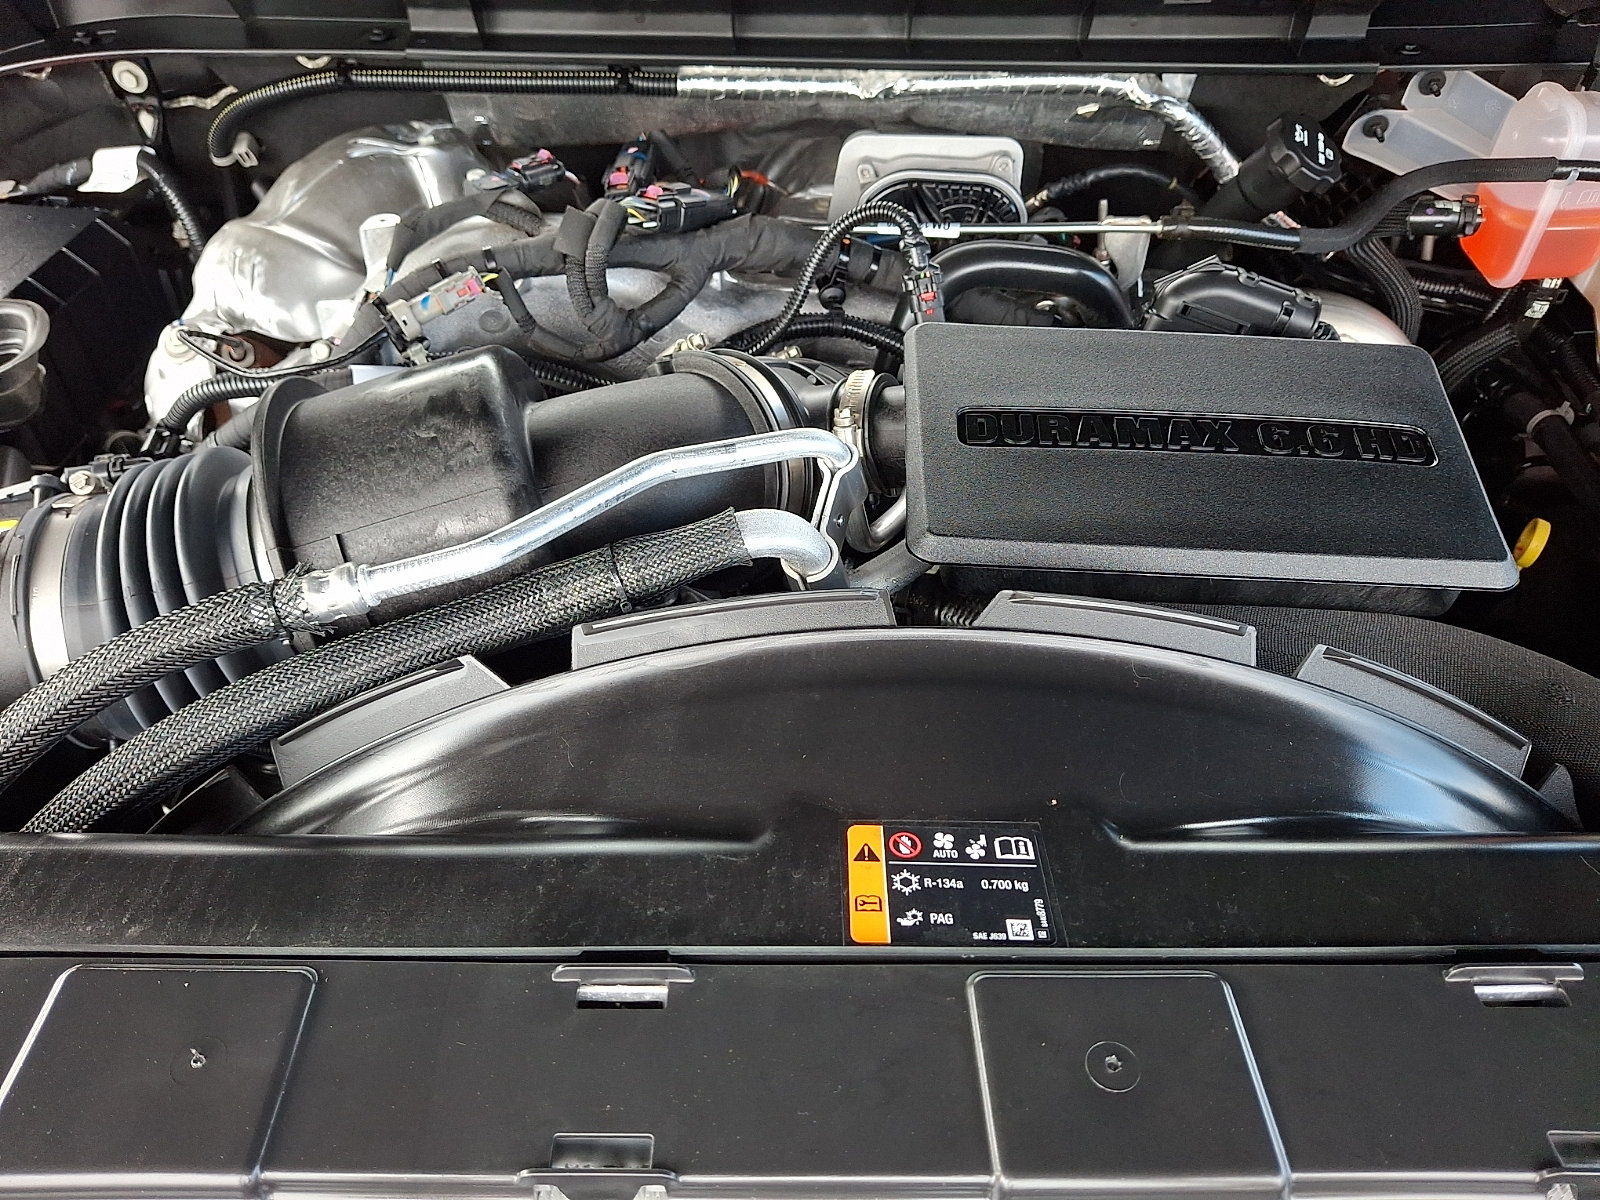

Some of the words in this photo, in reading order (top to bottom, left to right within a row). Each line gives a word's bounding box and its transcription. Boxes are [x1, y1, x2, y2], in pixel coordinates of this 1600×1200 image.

[964, 413, 1239, 451] DURAMAX
[1257, 422, 1345, 457] 6.6
[1352, 426, 1429, 462] HD
[932, 849, 959, 859] AUTO
[923, 878, 964, 890] R-134a
[980, 879, 1012, 890] 0.700
[1014, 880, 1029, 892] kg
[929, 913, 954, 925] PAG
[972, 931, 988, 940] SAE
